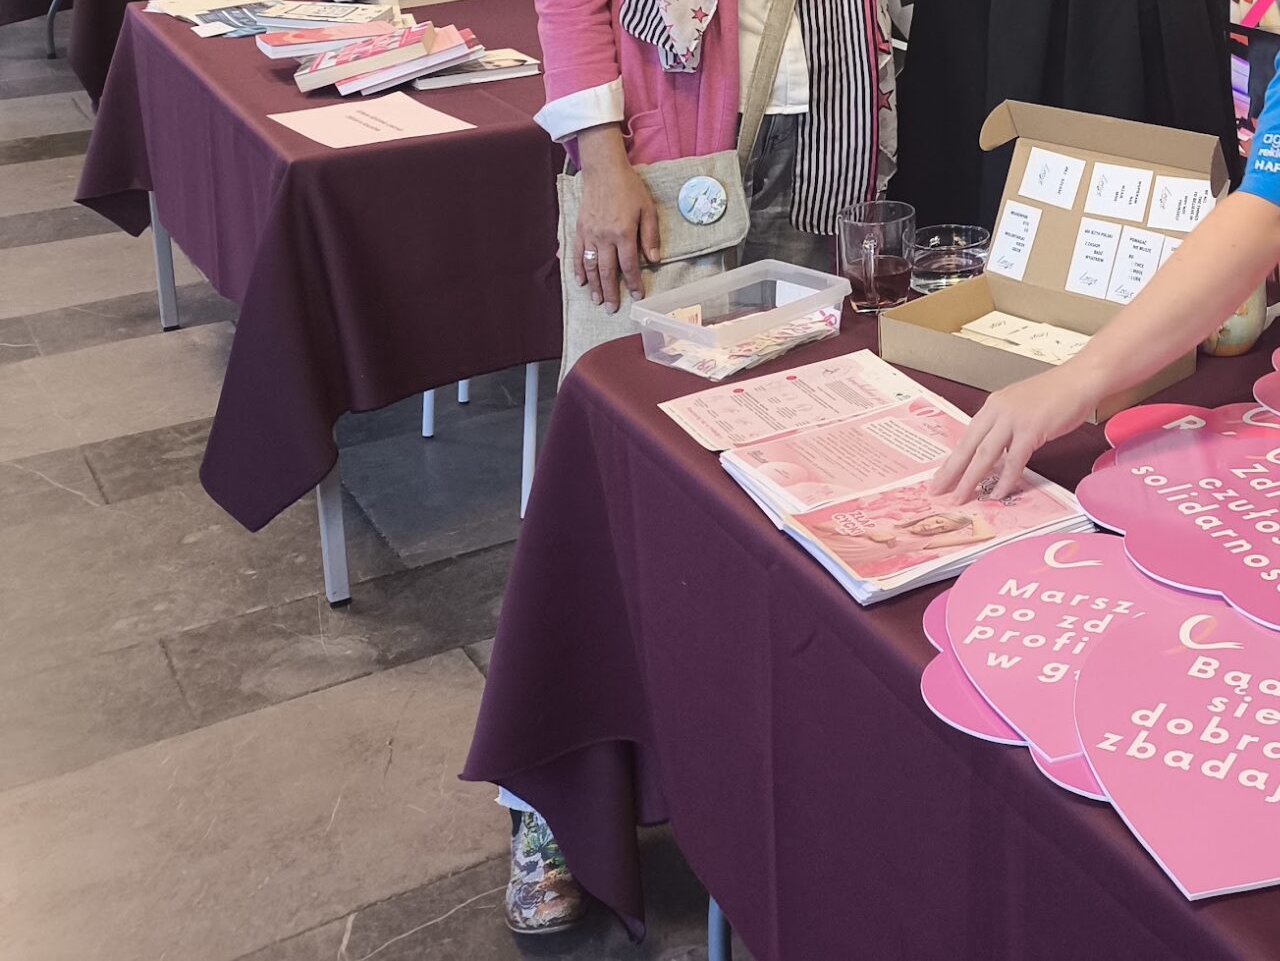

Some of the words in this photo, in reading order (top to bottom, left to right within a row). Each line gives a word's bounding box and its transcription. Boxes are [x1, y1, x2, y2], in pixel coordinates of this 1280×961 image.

[998, 579, 1146, 619] Marsz,
[975, 604, 1036, 622] po
[1056, 614, 1114, 633] zd
[963, 625, 1090, 654] profi
[986, 652, 1022, 668] w
[1037, 662, 1080, 683] g
